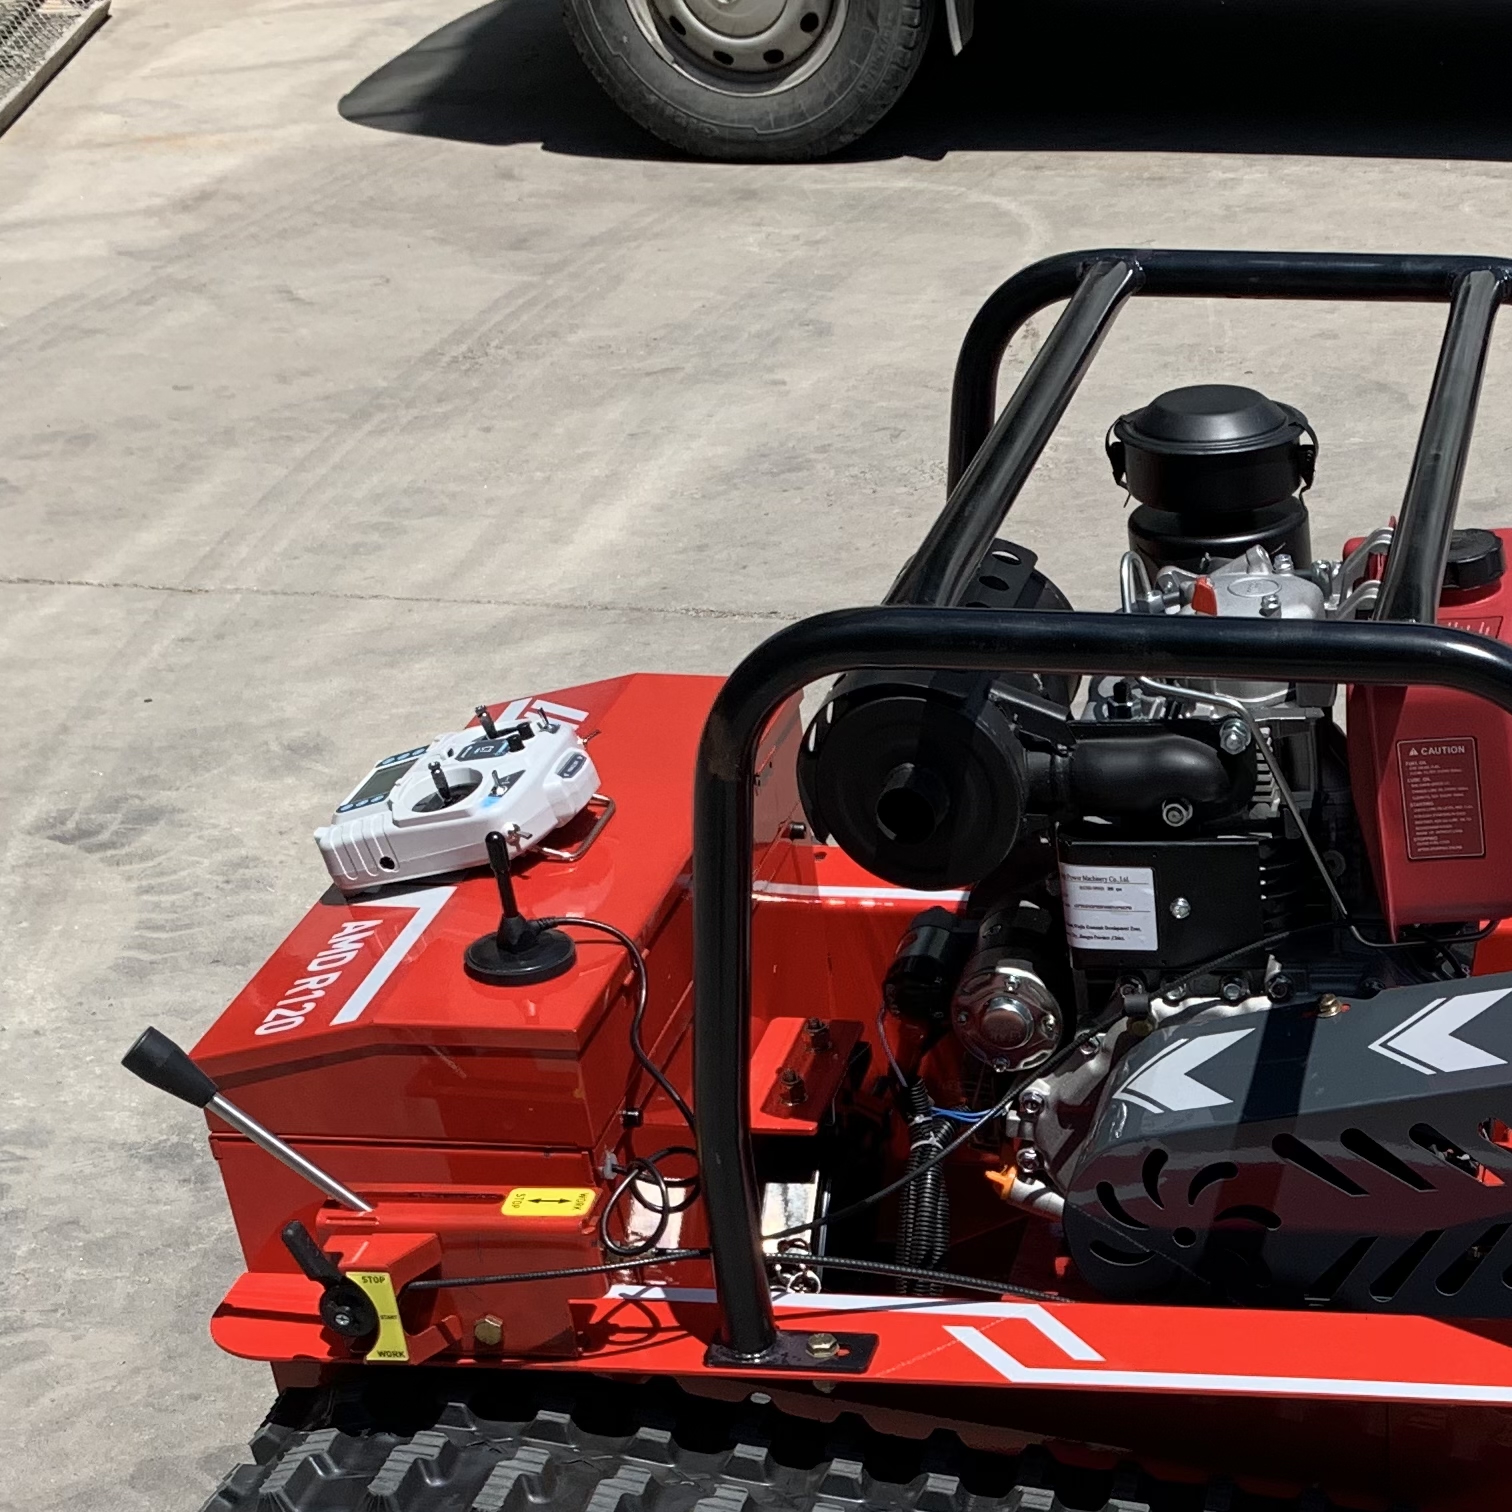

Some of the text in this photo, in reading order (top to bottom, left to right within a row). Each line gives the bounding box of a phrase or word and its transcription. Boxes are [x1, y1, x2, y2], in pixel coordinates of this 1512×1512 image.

[1421, 745, 1465, 756] CAUTION
[254, 971, 342, 1035] R120
[512, 1193, 526, 1209] STOP
[573, 1192, 589, 1210] WORK
[362, 1276, 385, 1284] STOP
[377, 1350, 405, 1358] WORK
